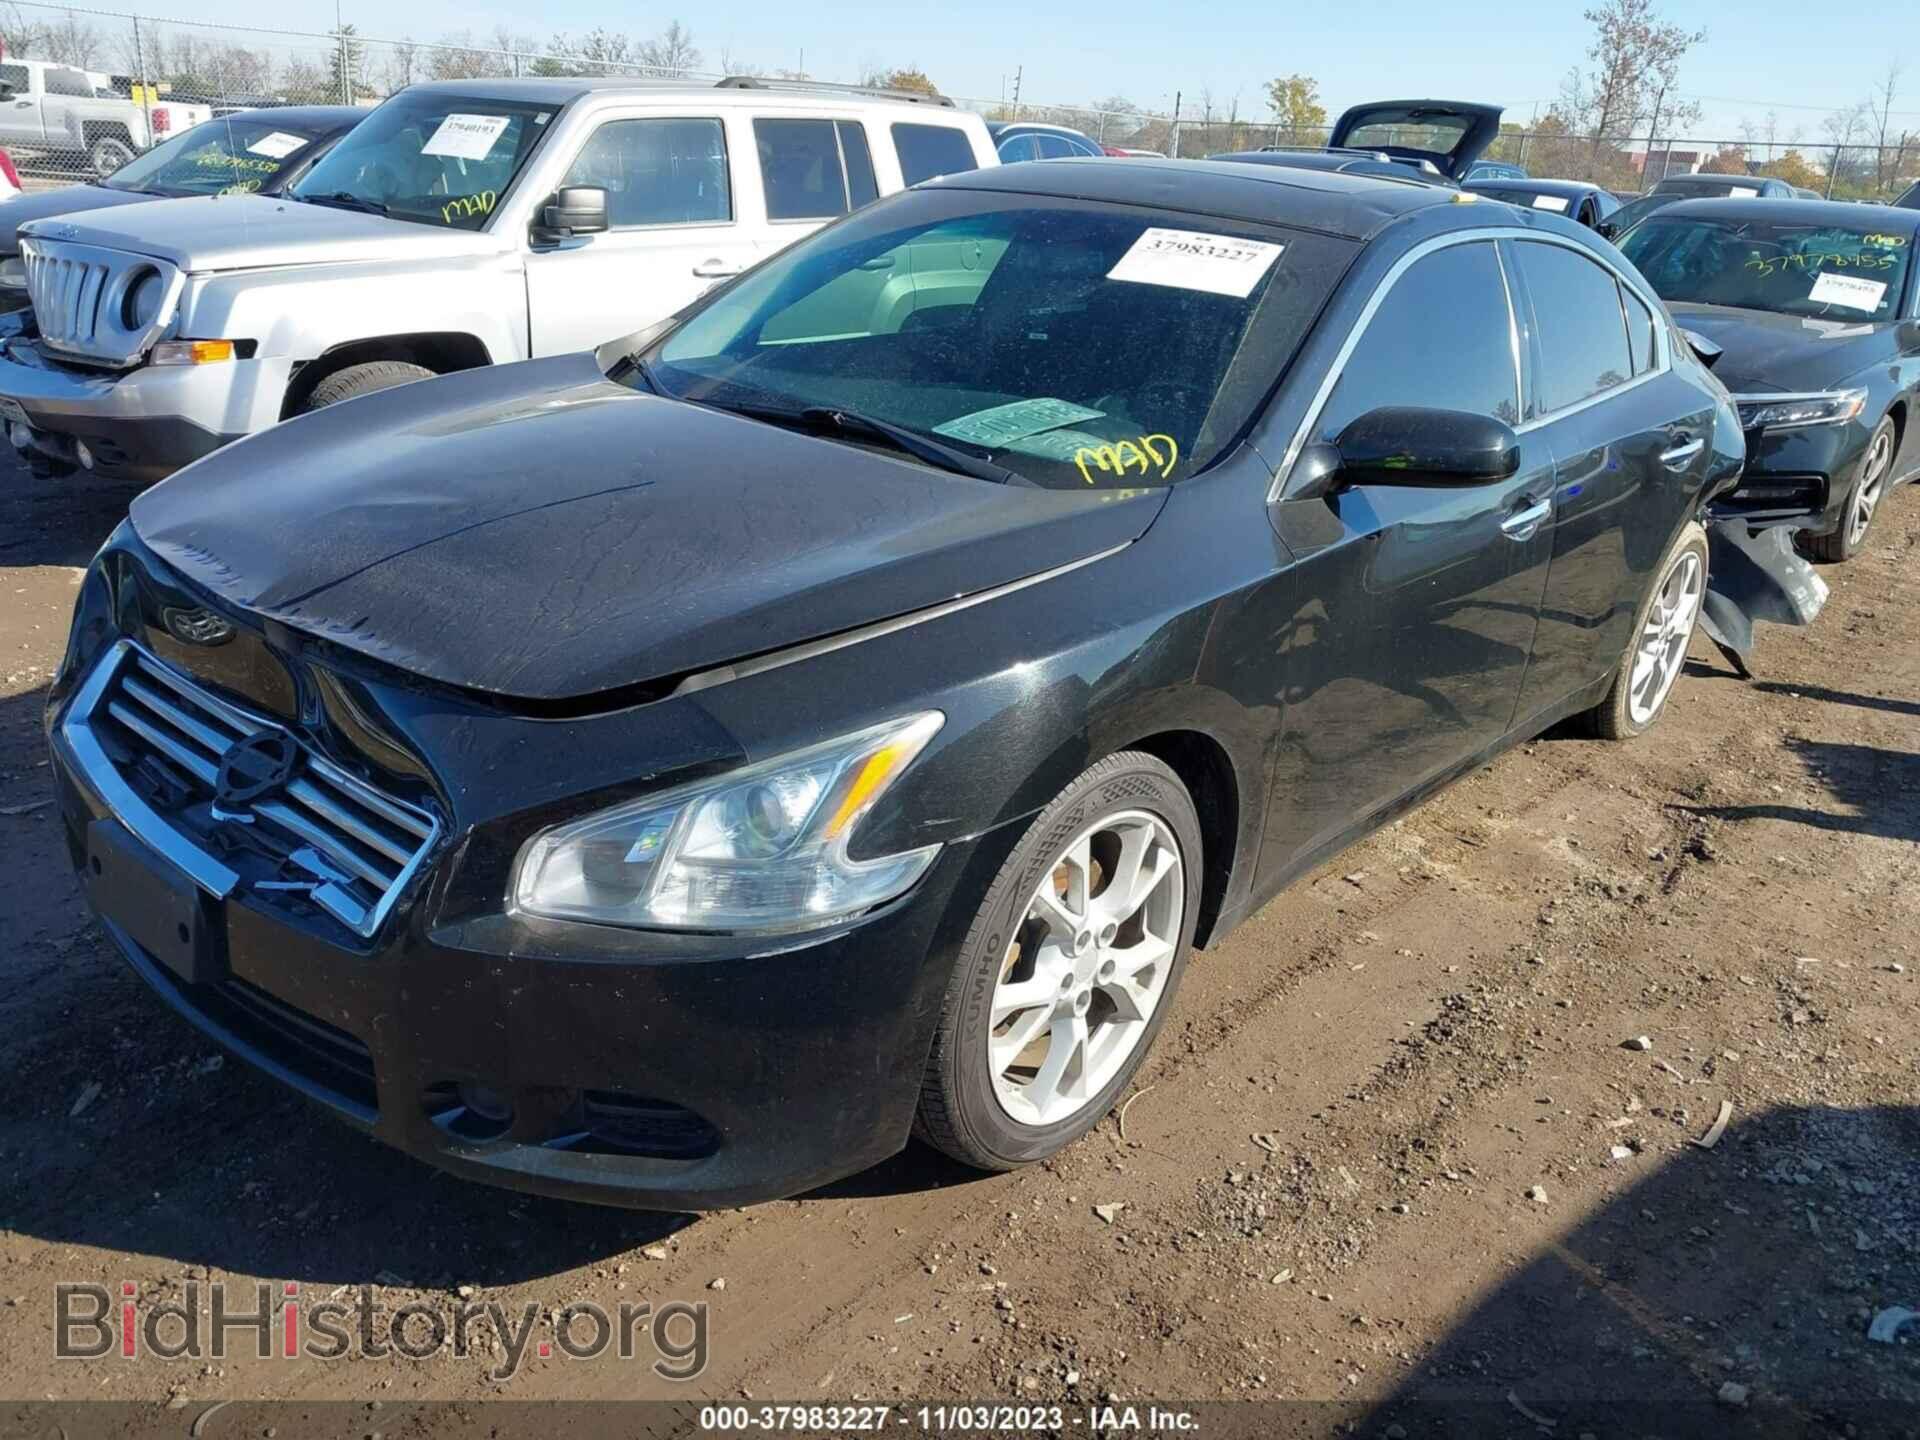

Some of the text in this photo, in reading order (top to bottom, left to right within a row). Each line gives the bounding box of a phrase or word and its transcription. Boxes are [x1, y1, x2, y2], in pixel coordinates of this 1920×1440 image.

[442, 191, 497, 224] MAD
[1147, 239, 1258, 263] 37983227
[1074, 434, 1179, 484] MAD
[965, 934, 1000, 1041] KUMHO
